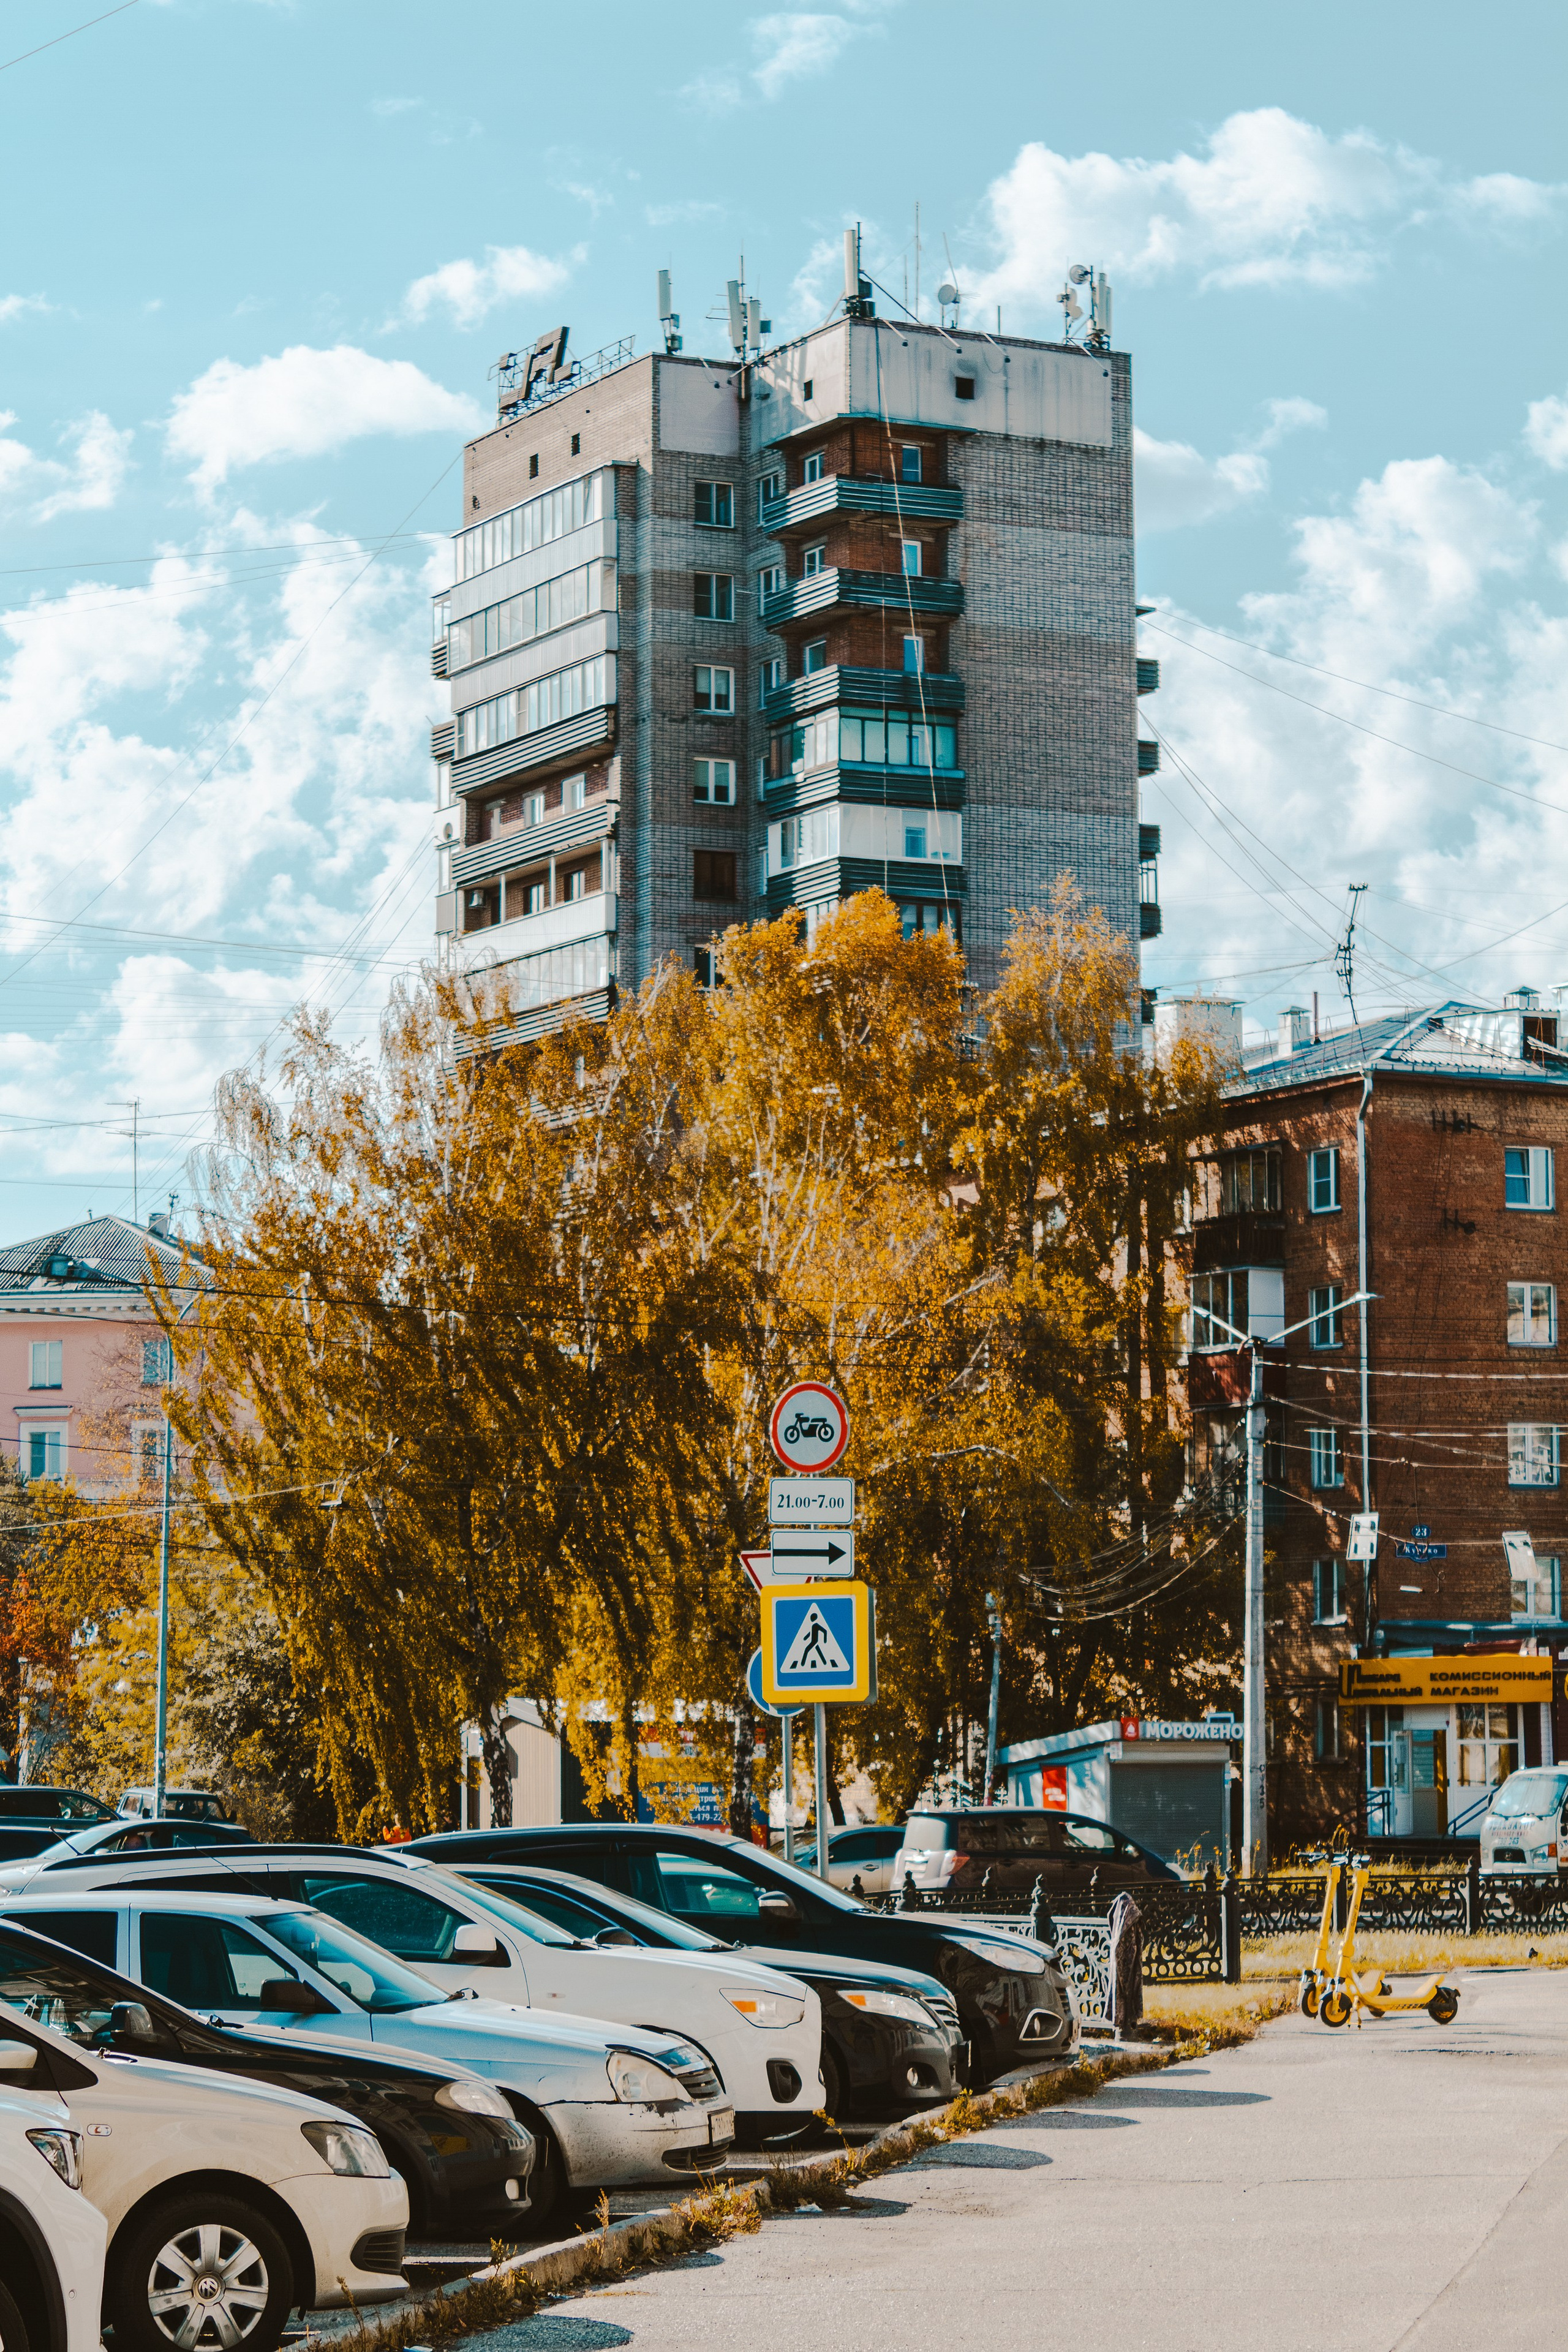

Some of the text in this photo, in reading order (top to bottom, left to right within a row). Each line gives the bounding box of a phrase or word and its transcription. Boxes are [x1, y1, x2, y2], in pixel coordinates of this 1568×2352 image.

[777, 1494, 845, 1509] 21.00-7.00
[1430, 1670, 1551, 1681] КОМИССИОННЫЙ
[1430, 1686, 1499, 1696] МАГАЗИН
[1145, 1723, 1244, 1739] МОРОЖЕНО
